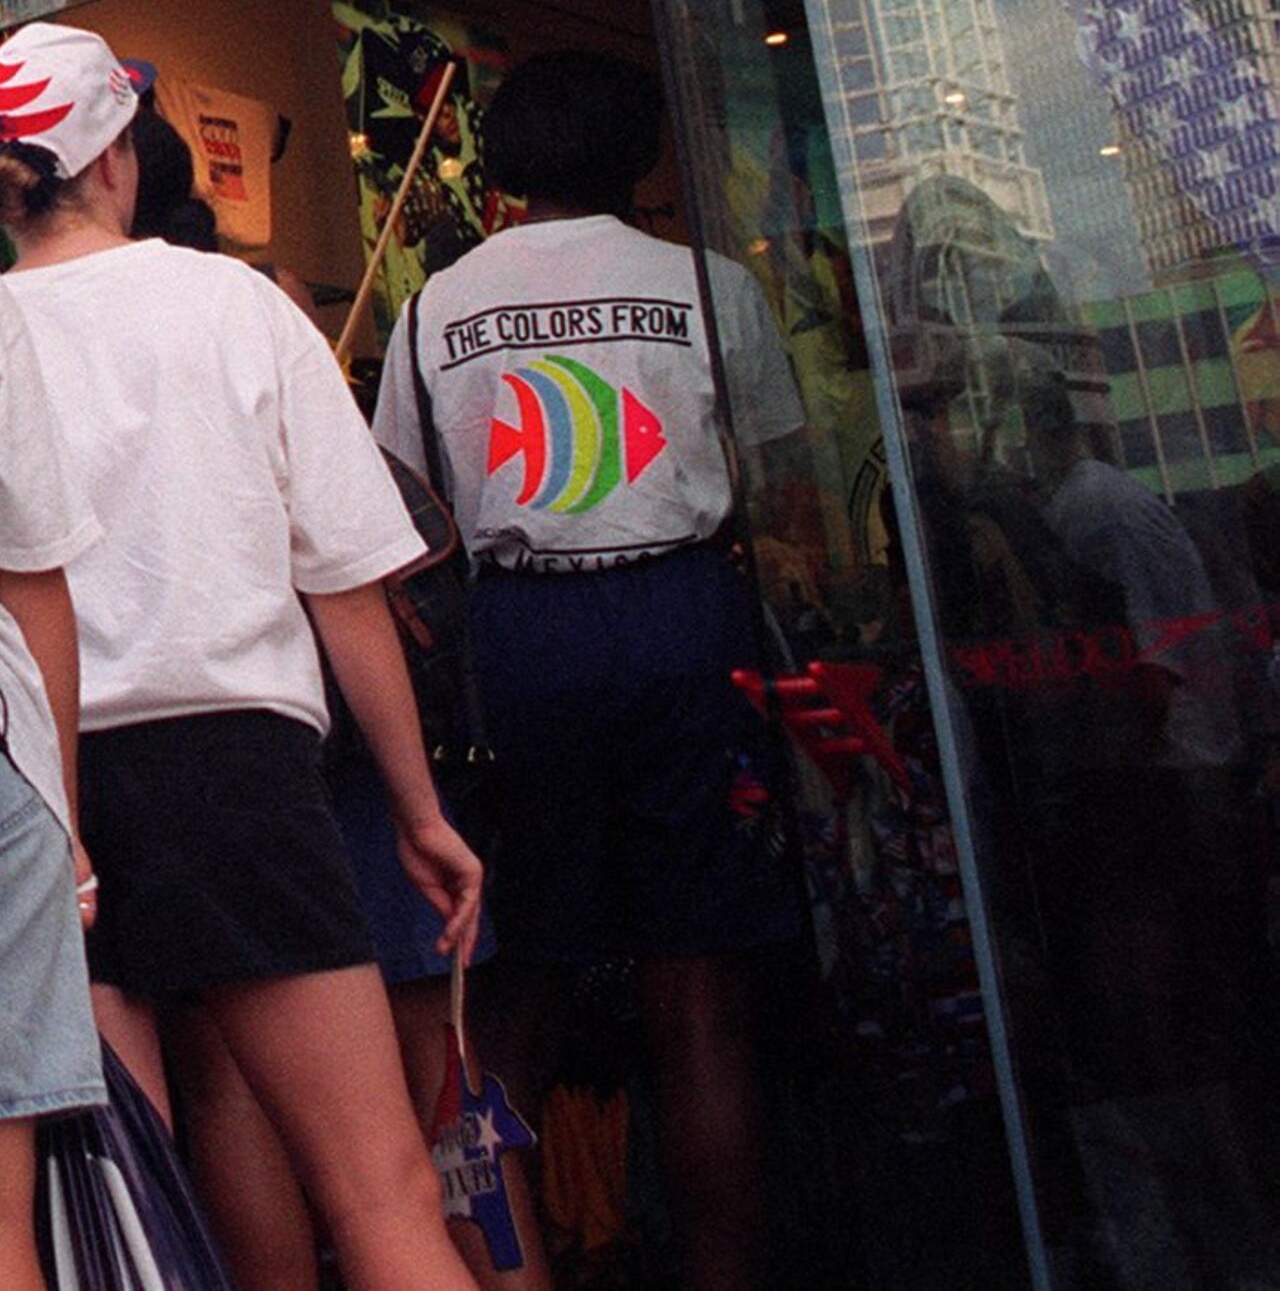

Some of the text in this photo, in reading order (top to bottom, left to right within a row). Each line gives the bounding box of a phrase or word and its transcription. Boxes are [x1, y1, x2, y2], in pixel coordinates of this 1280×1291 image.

[443, 304, 689, 360] THE COLORS FROM
